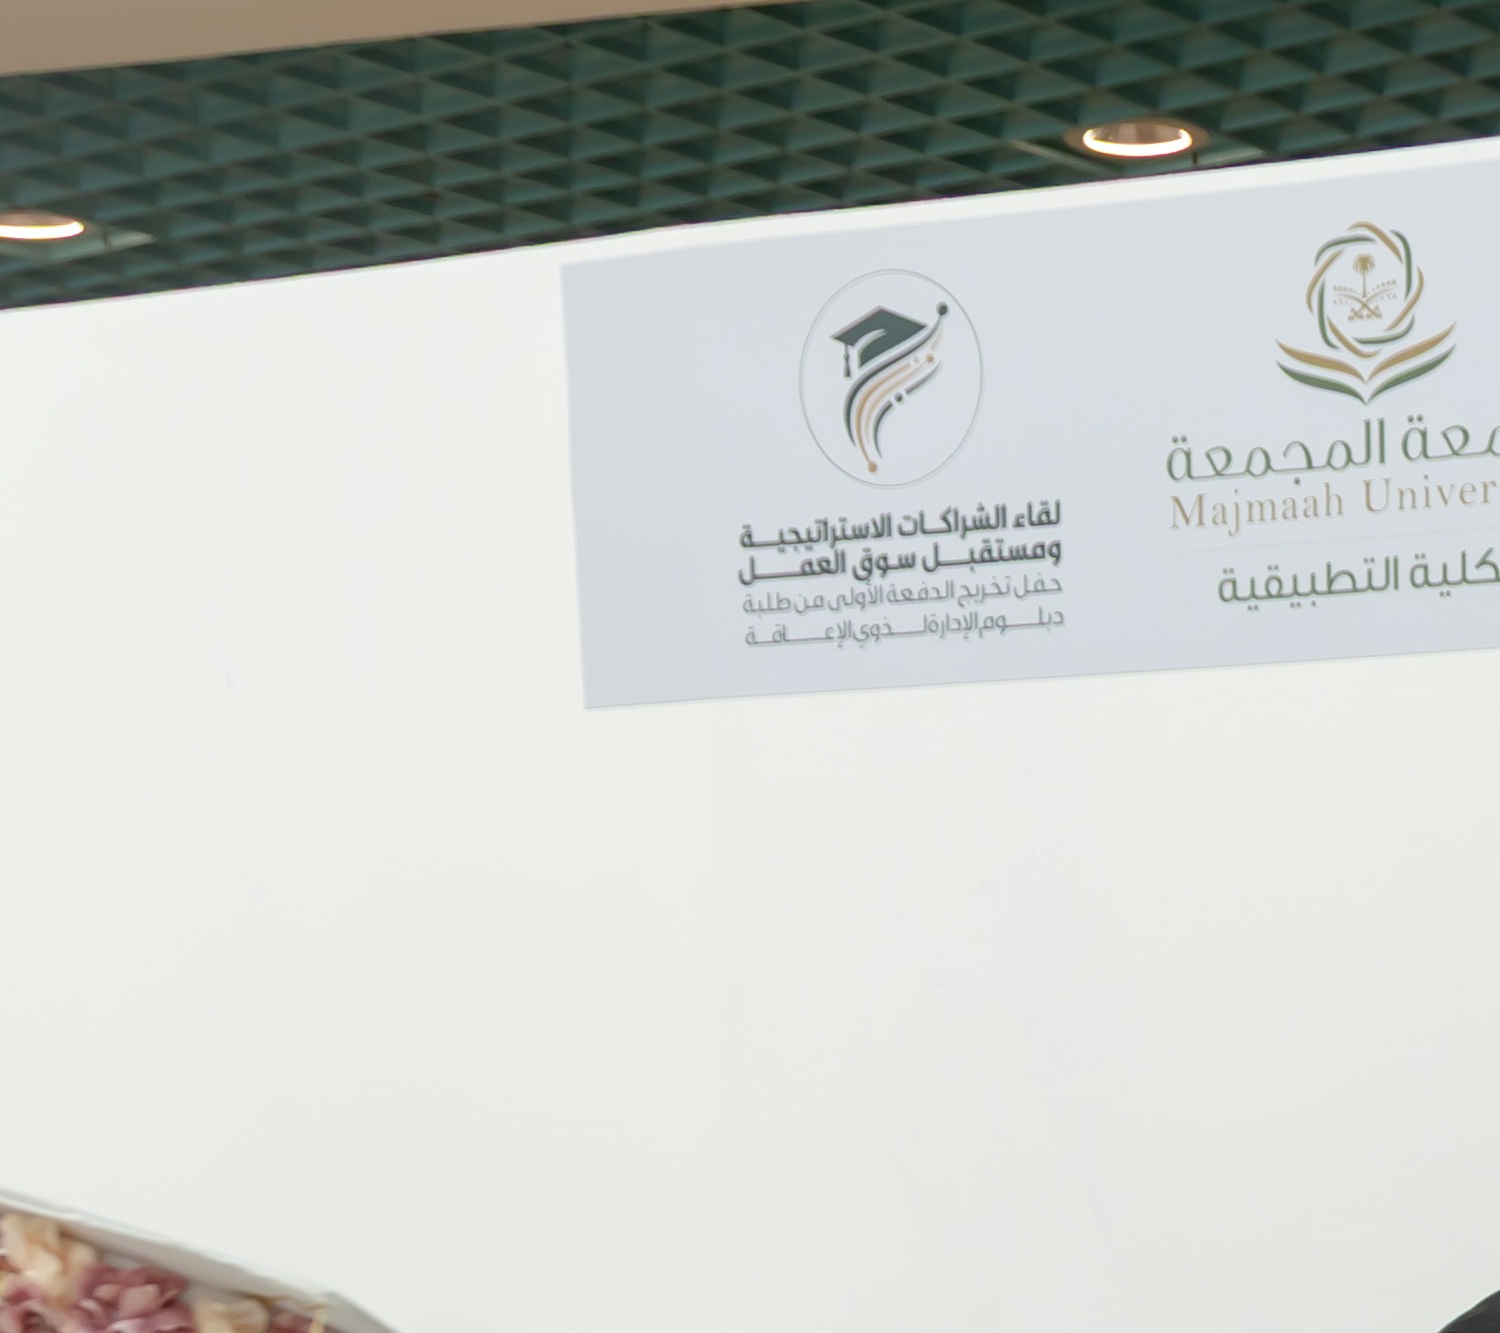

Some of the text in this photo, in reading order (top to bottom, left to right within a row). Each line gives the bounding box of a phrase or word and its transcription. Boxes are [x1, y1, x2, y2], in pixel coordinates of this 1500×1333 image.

[1166, 416, 1387, 487] المجمعة
[1012, 498, 1062, 528] لقاء
[1170, 481, 1345, 537] Majmaah
[851, 547, 916, 582] سوق
[1013, 572, 1063, 599] حفل
[1217, 555, 1400, 612] التطبيقية
